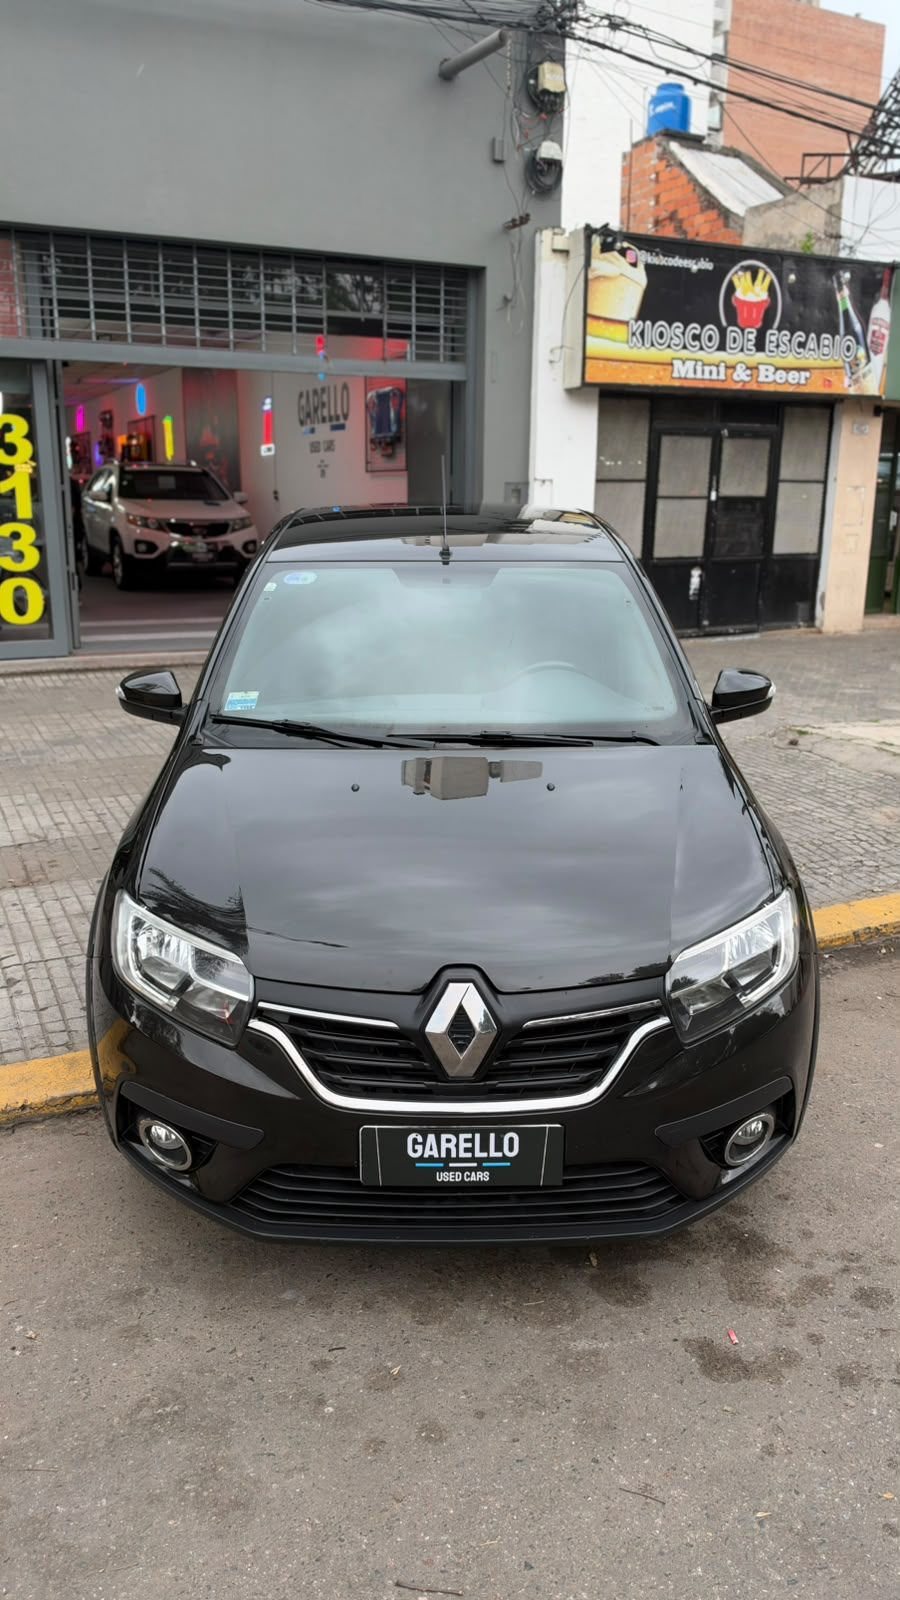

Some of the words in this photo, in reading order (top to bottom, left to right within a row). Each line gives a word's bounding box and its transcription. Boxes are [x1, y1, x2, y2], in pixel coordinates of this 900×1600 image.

[628, 320, 721, 353] KIOSCO
[726, 327, 757, 355] DE
[765, 329, 857, 361] ESCABIO
[672, 357, 727, 382] Mini
[733, 362, 752, 382] &
[757, 363, 811, 386] Beer
[297, 381, 350, 427] GARELLO
[407, 1132, 519, 1158] GARELLO
[436, 1171, 462, 1182] USED
[464, 1171, 490, 1182] CARS
